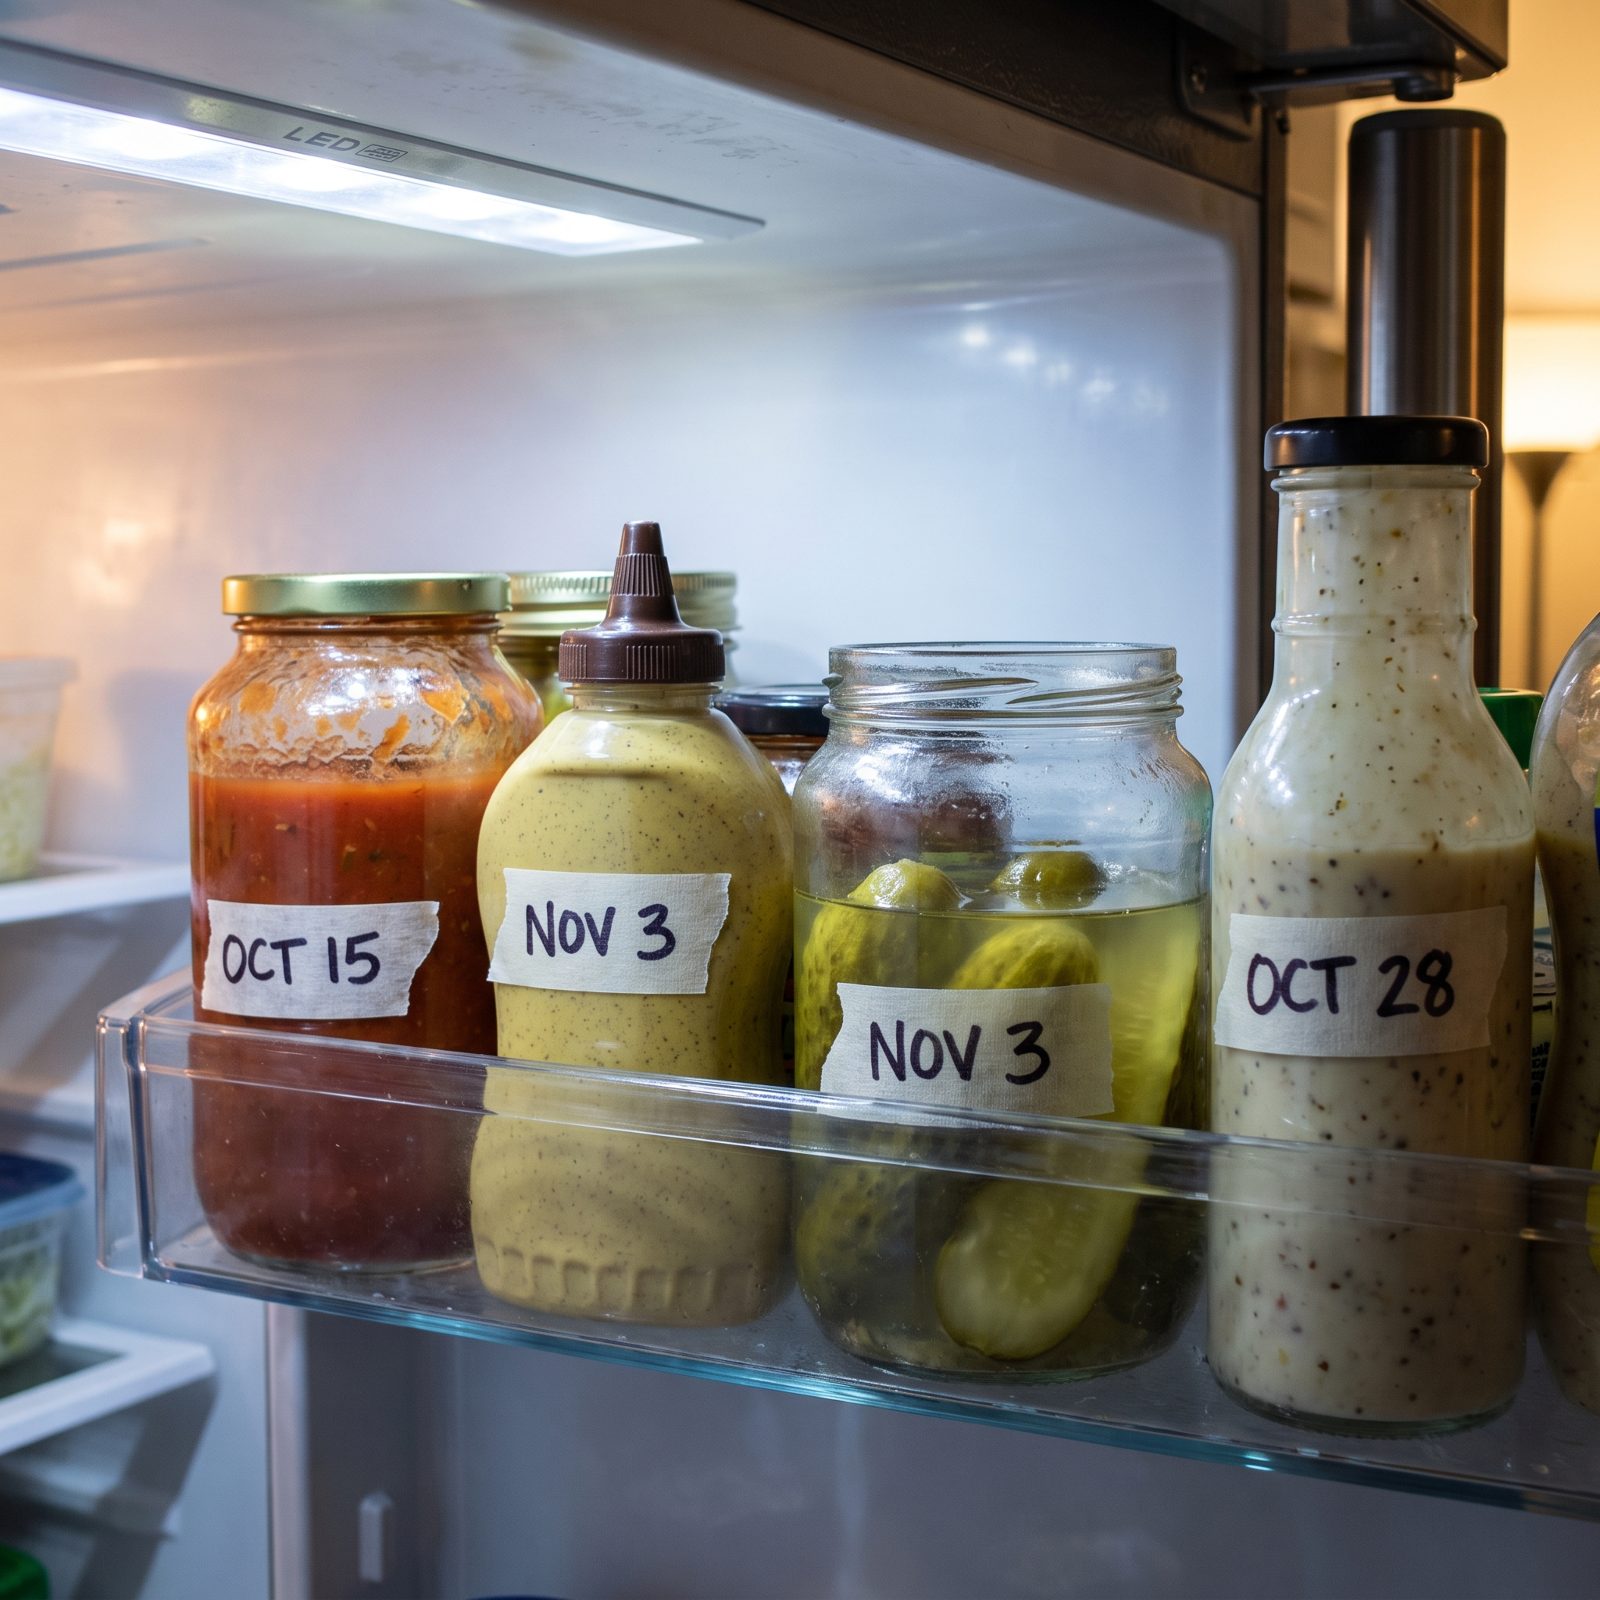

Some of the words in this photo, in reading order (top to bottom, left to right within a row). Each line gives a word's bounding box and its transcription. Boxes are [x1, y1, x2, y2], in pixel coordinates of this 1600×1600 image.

[282, 126, 361, 151] LED
[222, 933, 308, 985] OCT
[327, 930, 381, 985] 15
[525, 900, 616, 958] NOV
[636, 903, 677, 961] 3
[1246, 953, 1358, 1016] OCT
[1376, 948, 1456, 1018] 28
[869, 1019, 983, 1082] NOV
[1005, 1020, 1051, 1085] 3
